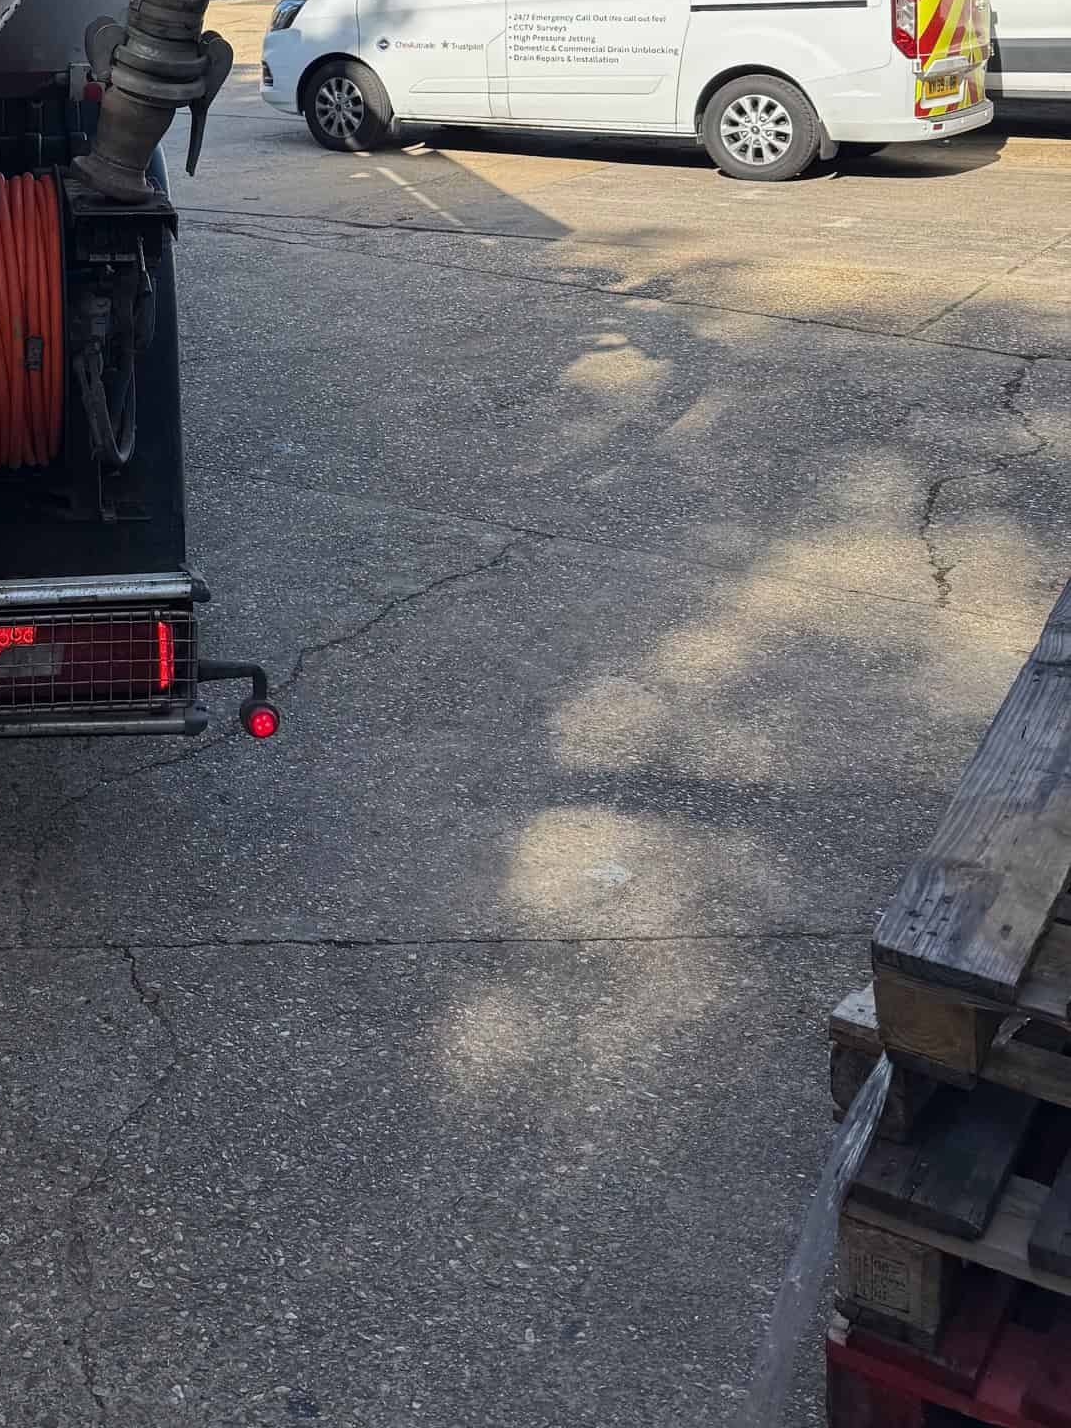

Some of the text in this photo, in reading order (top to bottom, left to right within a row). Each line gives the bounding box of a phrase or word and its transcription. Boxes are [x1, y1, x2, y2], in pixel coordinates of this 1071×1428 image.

[531, 14, 574, 23] Emergency
[592, 14, 608, 22] Out
[536, 24, 567, 33] Surveys
[513, 34, 597, 44] High Pressure Jetting
[513, 44, 549, 52] Domestic
[557, 45, 606, 53] Commercial
[607, 45, 630, 53] Drain
[631, 46, 680, 56] Unblocking
[536, 54, 566, 62] Repairs
[573, 55, 619, 64] Installation
